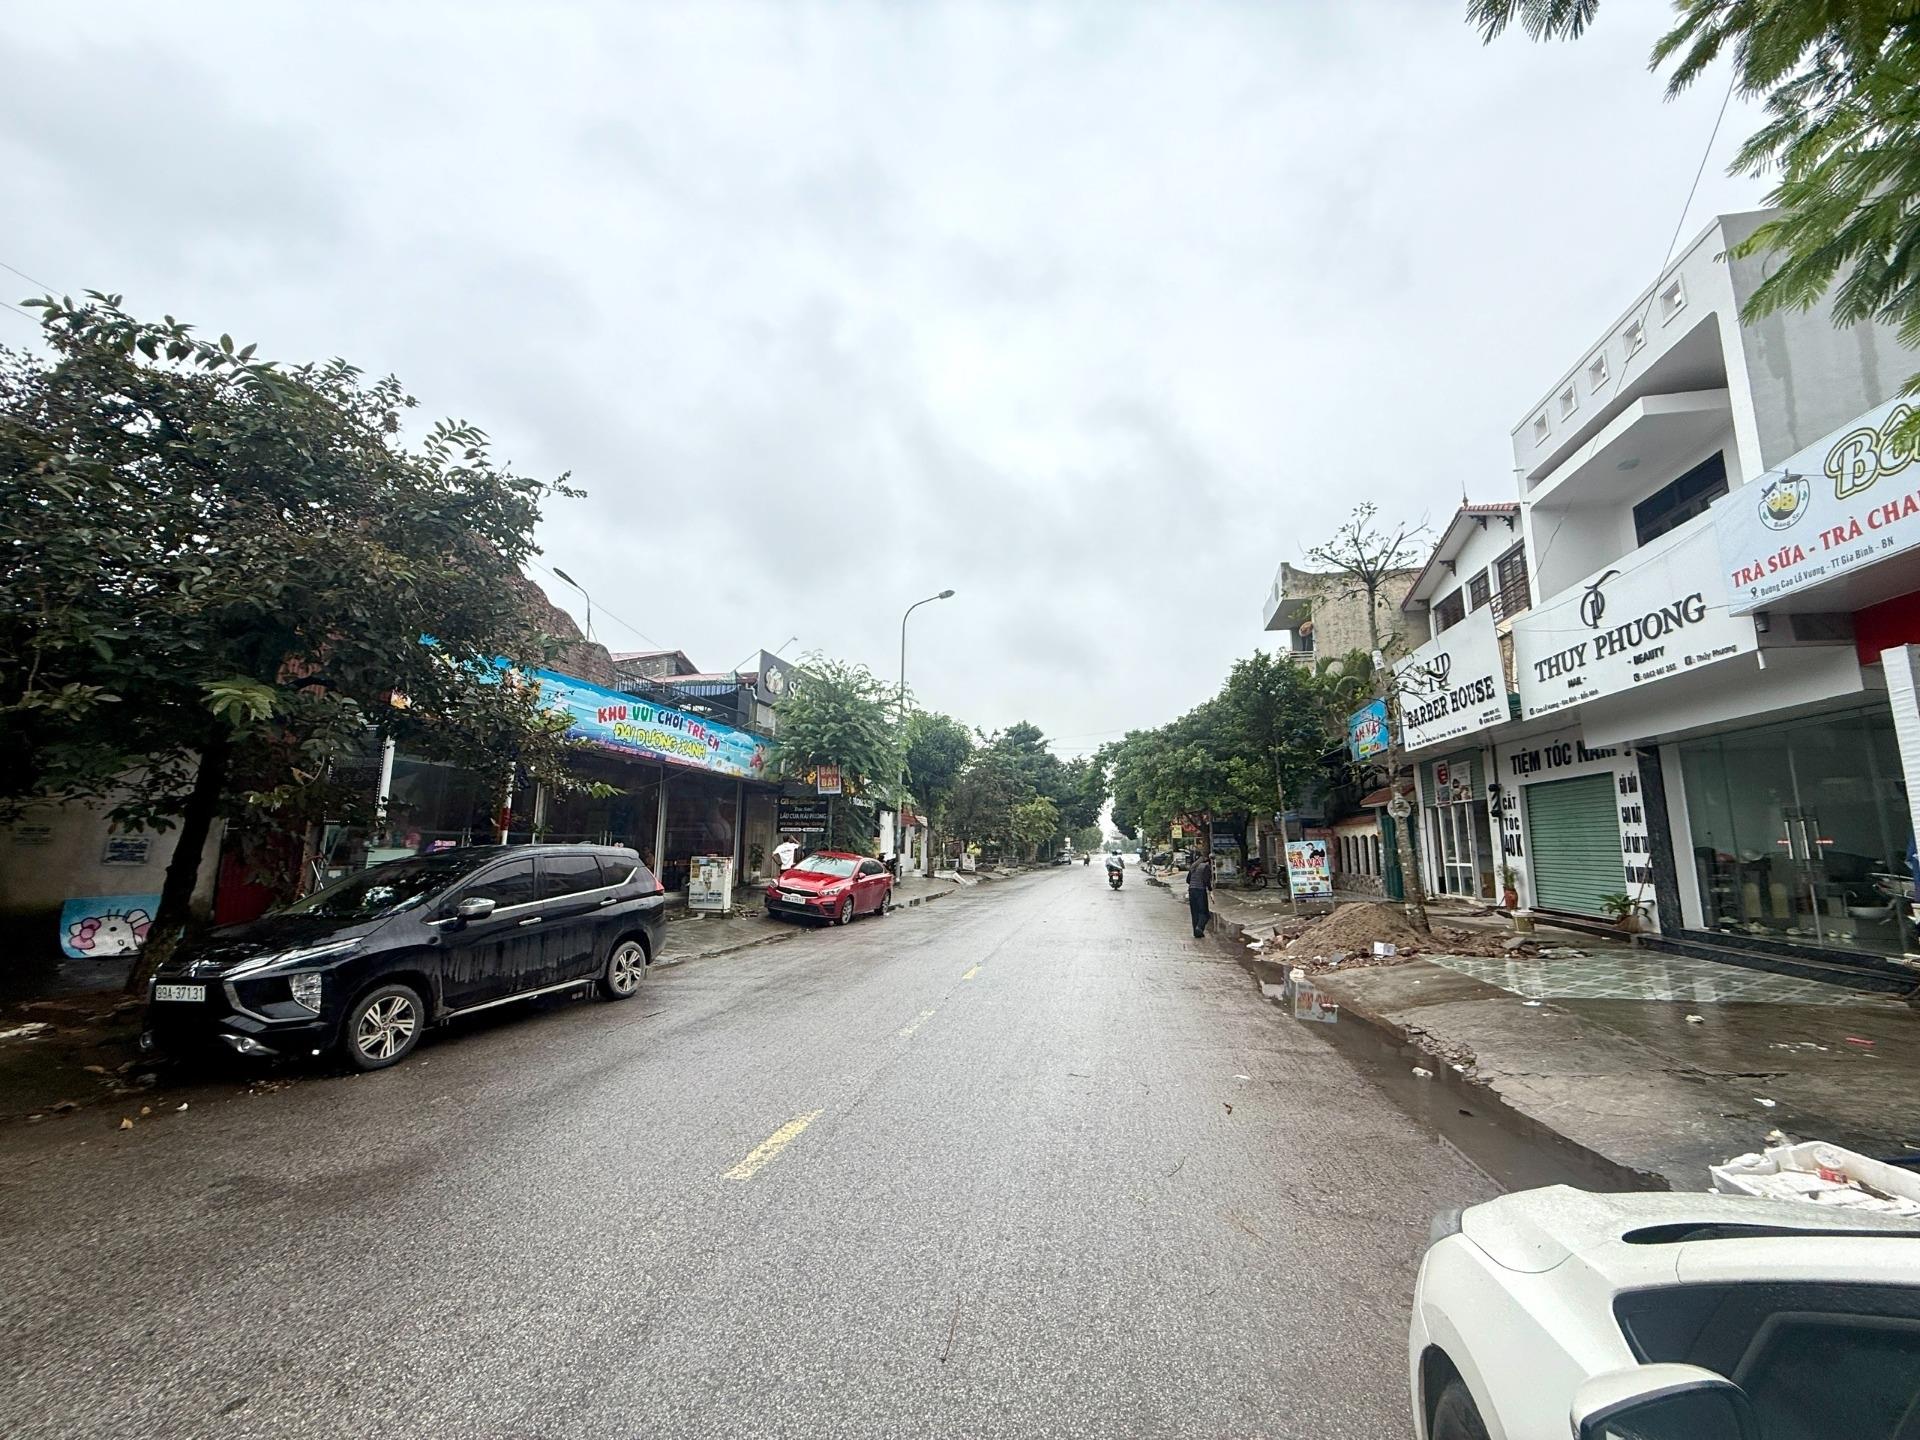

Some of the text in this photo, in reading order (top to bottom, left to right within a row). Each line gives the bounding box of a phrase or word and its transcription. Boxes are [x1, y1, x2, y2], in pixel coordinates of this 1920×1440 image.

[1732, 490, 1920, 588] TRÀ SỮA TRÀ CHA
[1781, 578, 1794, 588] Cao
[1831, 558, 1840, 569] TT
[1841, 553, 1854, 564] Gia
[1881, 536, 1894, 549] BN
[1534, 592, 1706, 683] THUY PHUONG
[1633, 646, 1665, 665] BEAUTY
[1406, 695, 1450, 730] BARBER
[1450, 675, 1496, 713] HOUSE
[598, 705, 627, 723] KHU
[632, 705, 654, 722] VUI
[658, 711, 684, 730] CHƠI
[707, 733, 721, 751] EM
[613, 722, 636, 746] ĐẠI
[678, 738, 707, 759] XANH
[1510, 747, 1541, 778] TIỆM
[1544, 739, 1572, 769] TÓC
[1502, 791, 1517, 810] CẮT
[1504, 813, 1520, 831] TÓC
